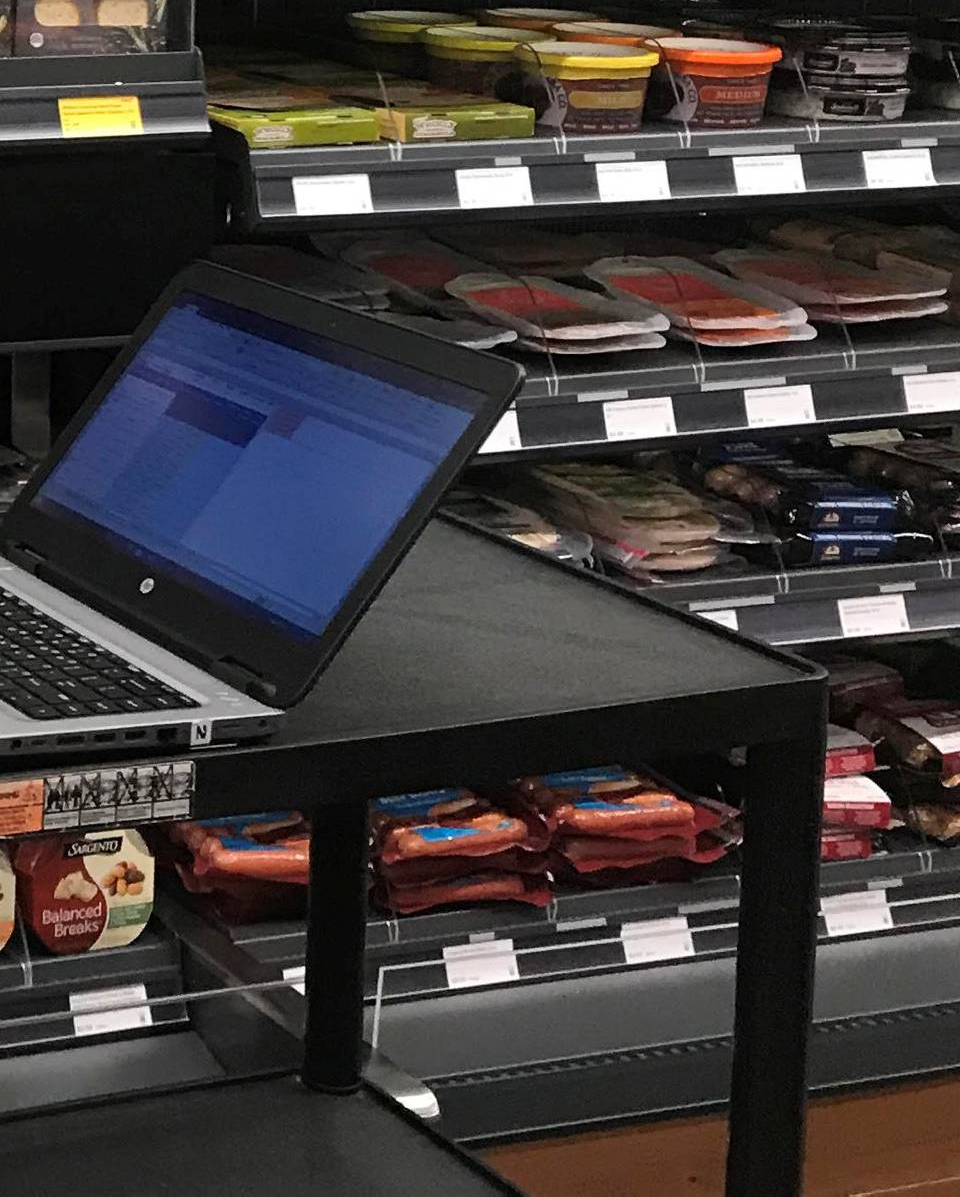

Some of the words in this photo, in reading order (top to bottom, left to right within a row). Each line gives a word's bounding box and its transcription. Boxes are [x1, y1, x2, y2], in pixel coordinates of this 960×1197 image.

[68, 840, 119, 856] SARGENTO
[42, 902, 103, 925] Balanced
[54, 921, 100, 938] Breaks
